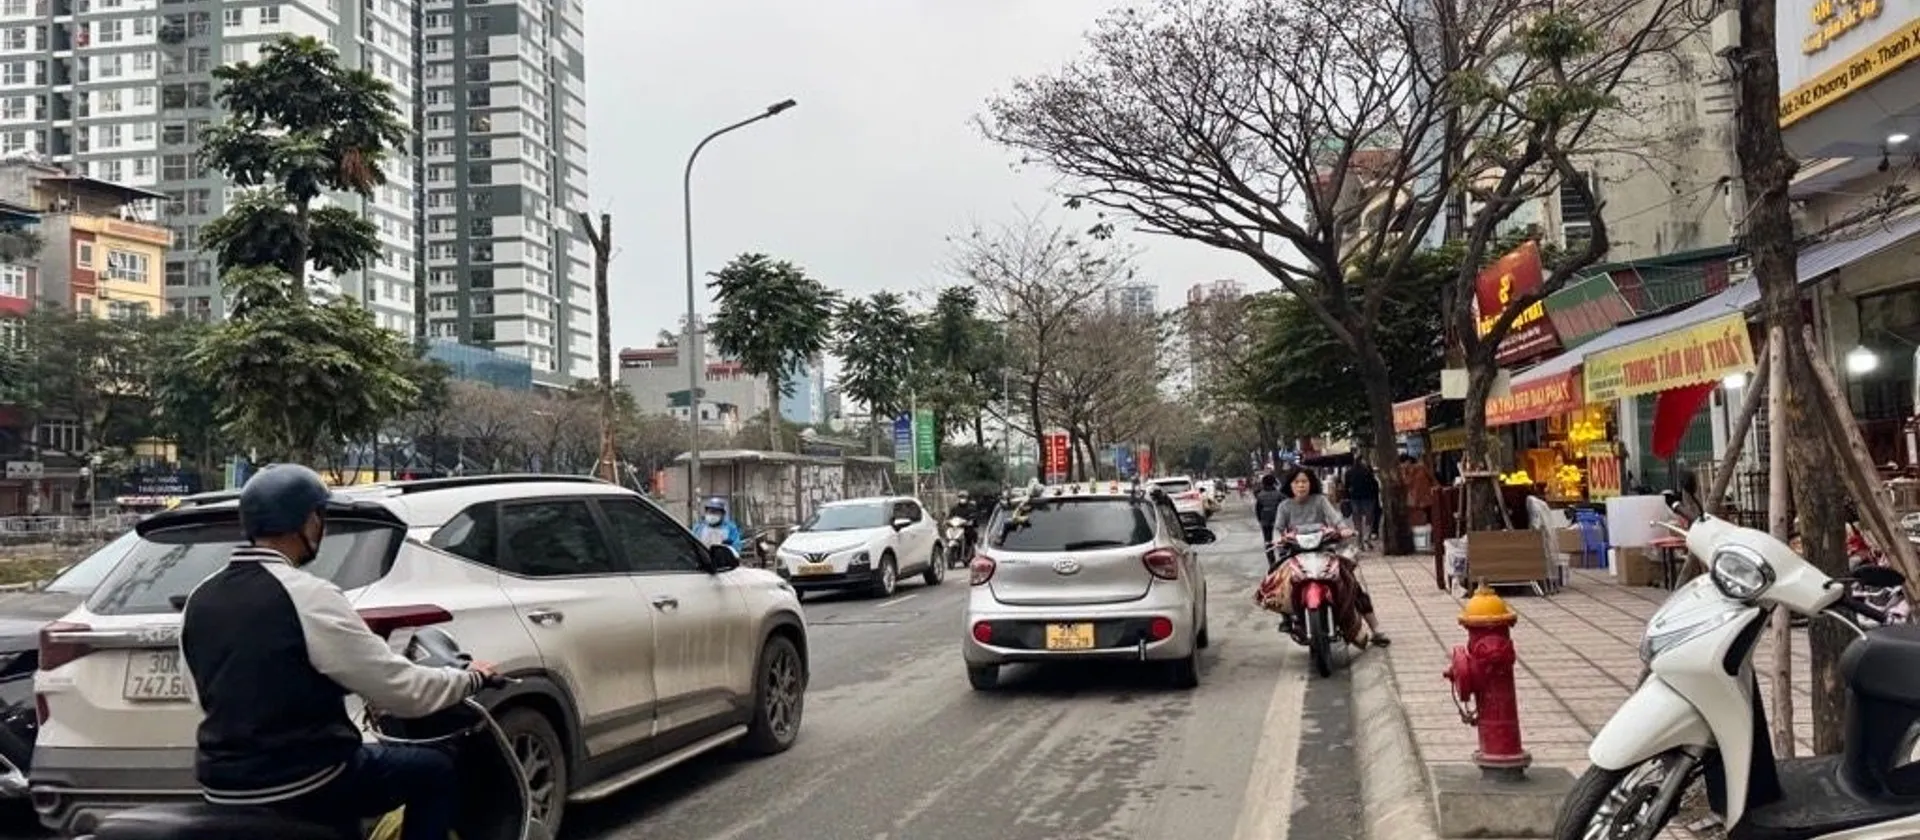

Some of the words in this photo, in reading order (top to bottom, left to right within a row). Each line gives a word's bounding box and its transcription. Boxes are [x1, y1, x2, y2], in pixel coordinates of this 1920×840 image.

[1877, 36, 1911, 65] Thanh
[1623, 355, 1658, 389] TRUNG
[1658, 346, 1684, 380] TÂM
[1684, 338, 1706, 379] NỘI
[1706, 325, 1745, 371] THẤT
